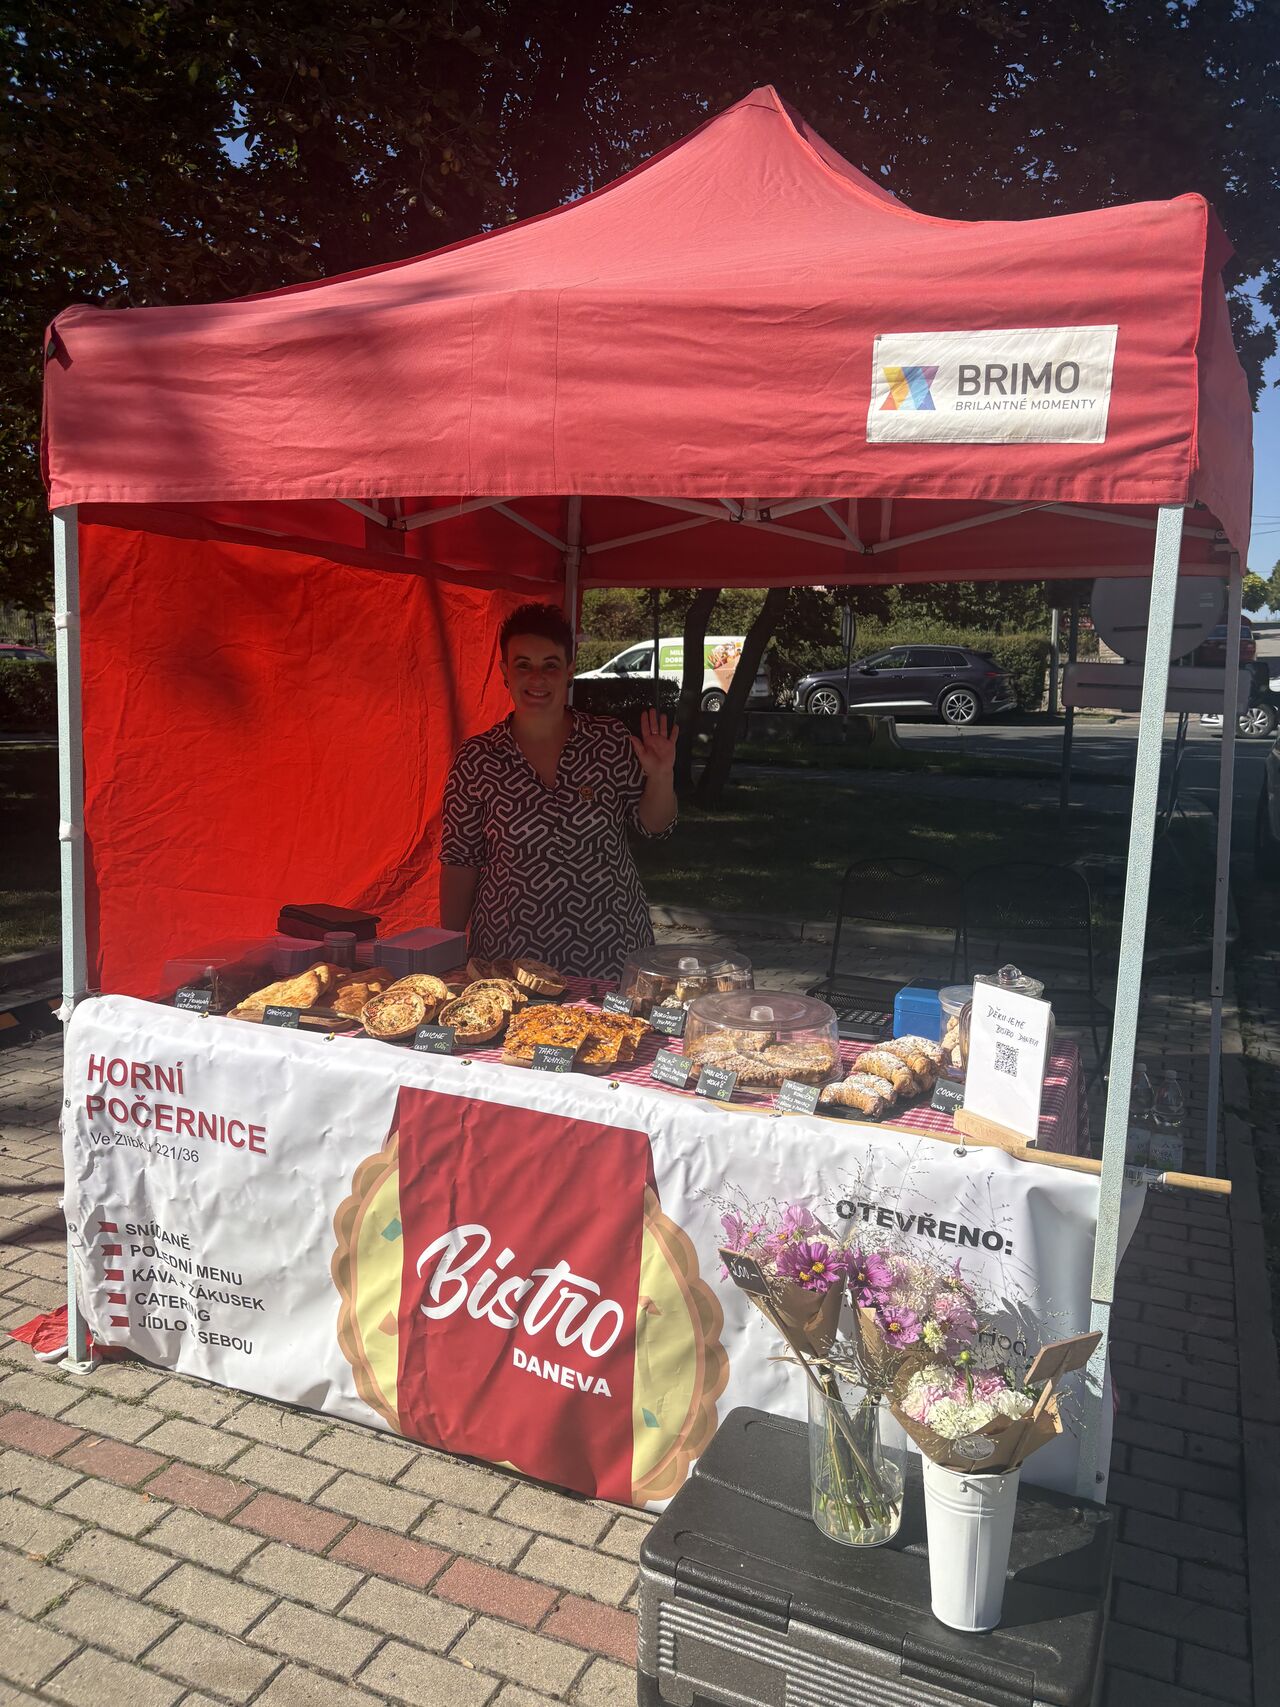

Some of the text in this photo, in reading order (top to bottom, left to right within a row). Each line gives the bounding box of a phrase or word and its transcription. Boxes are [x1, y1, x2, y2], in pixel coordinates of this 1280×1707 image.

[957, 361, 1080, 396] BRIMO
[955, 398, 1097, 411] BRILANTNÉ MOMENTY
[418, 1029, 448, 1040] QUICHE
[87, 1053, 184, 1095] HORNÍ
[86, 1094, 267, 1154] POČERNICE
[90, 1131, 111, 1146] Ve
[155, 1141, 200, 1163] 221/36
[125, 1220, 192, 1251] SNÍDANĚ
[836, 1200, 1014, 1256] OTEVŘENO:
[130, 1244, 243, 1286] POLEDNÍ MENU
[132, 1265, 178, 1287] KÁVA
[188, 1283, 266, 1311] ZÁKUSEK
[416, 1223, 624, 1358] Bistro
[138, 1312, 188, 1332] JÍDLO
[198, 1331, 253, 1355] SEBOU
[513, 1347, 612, 1398] DANEVA
